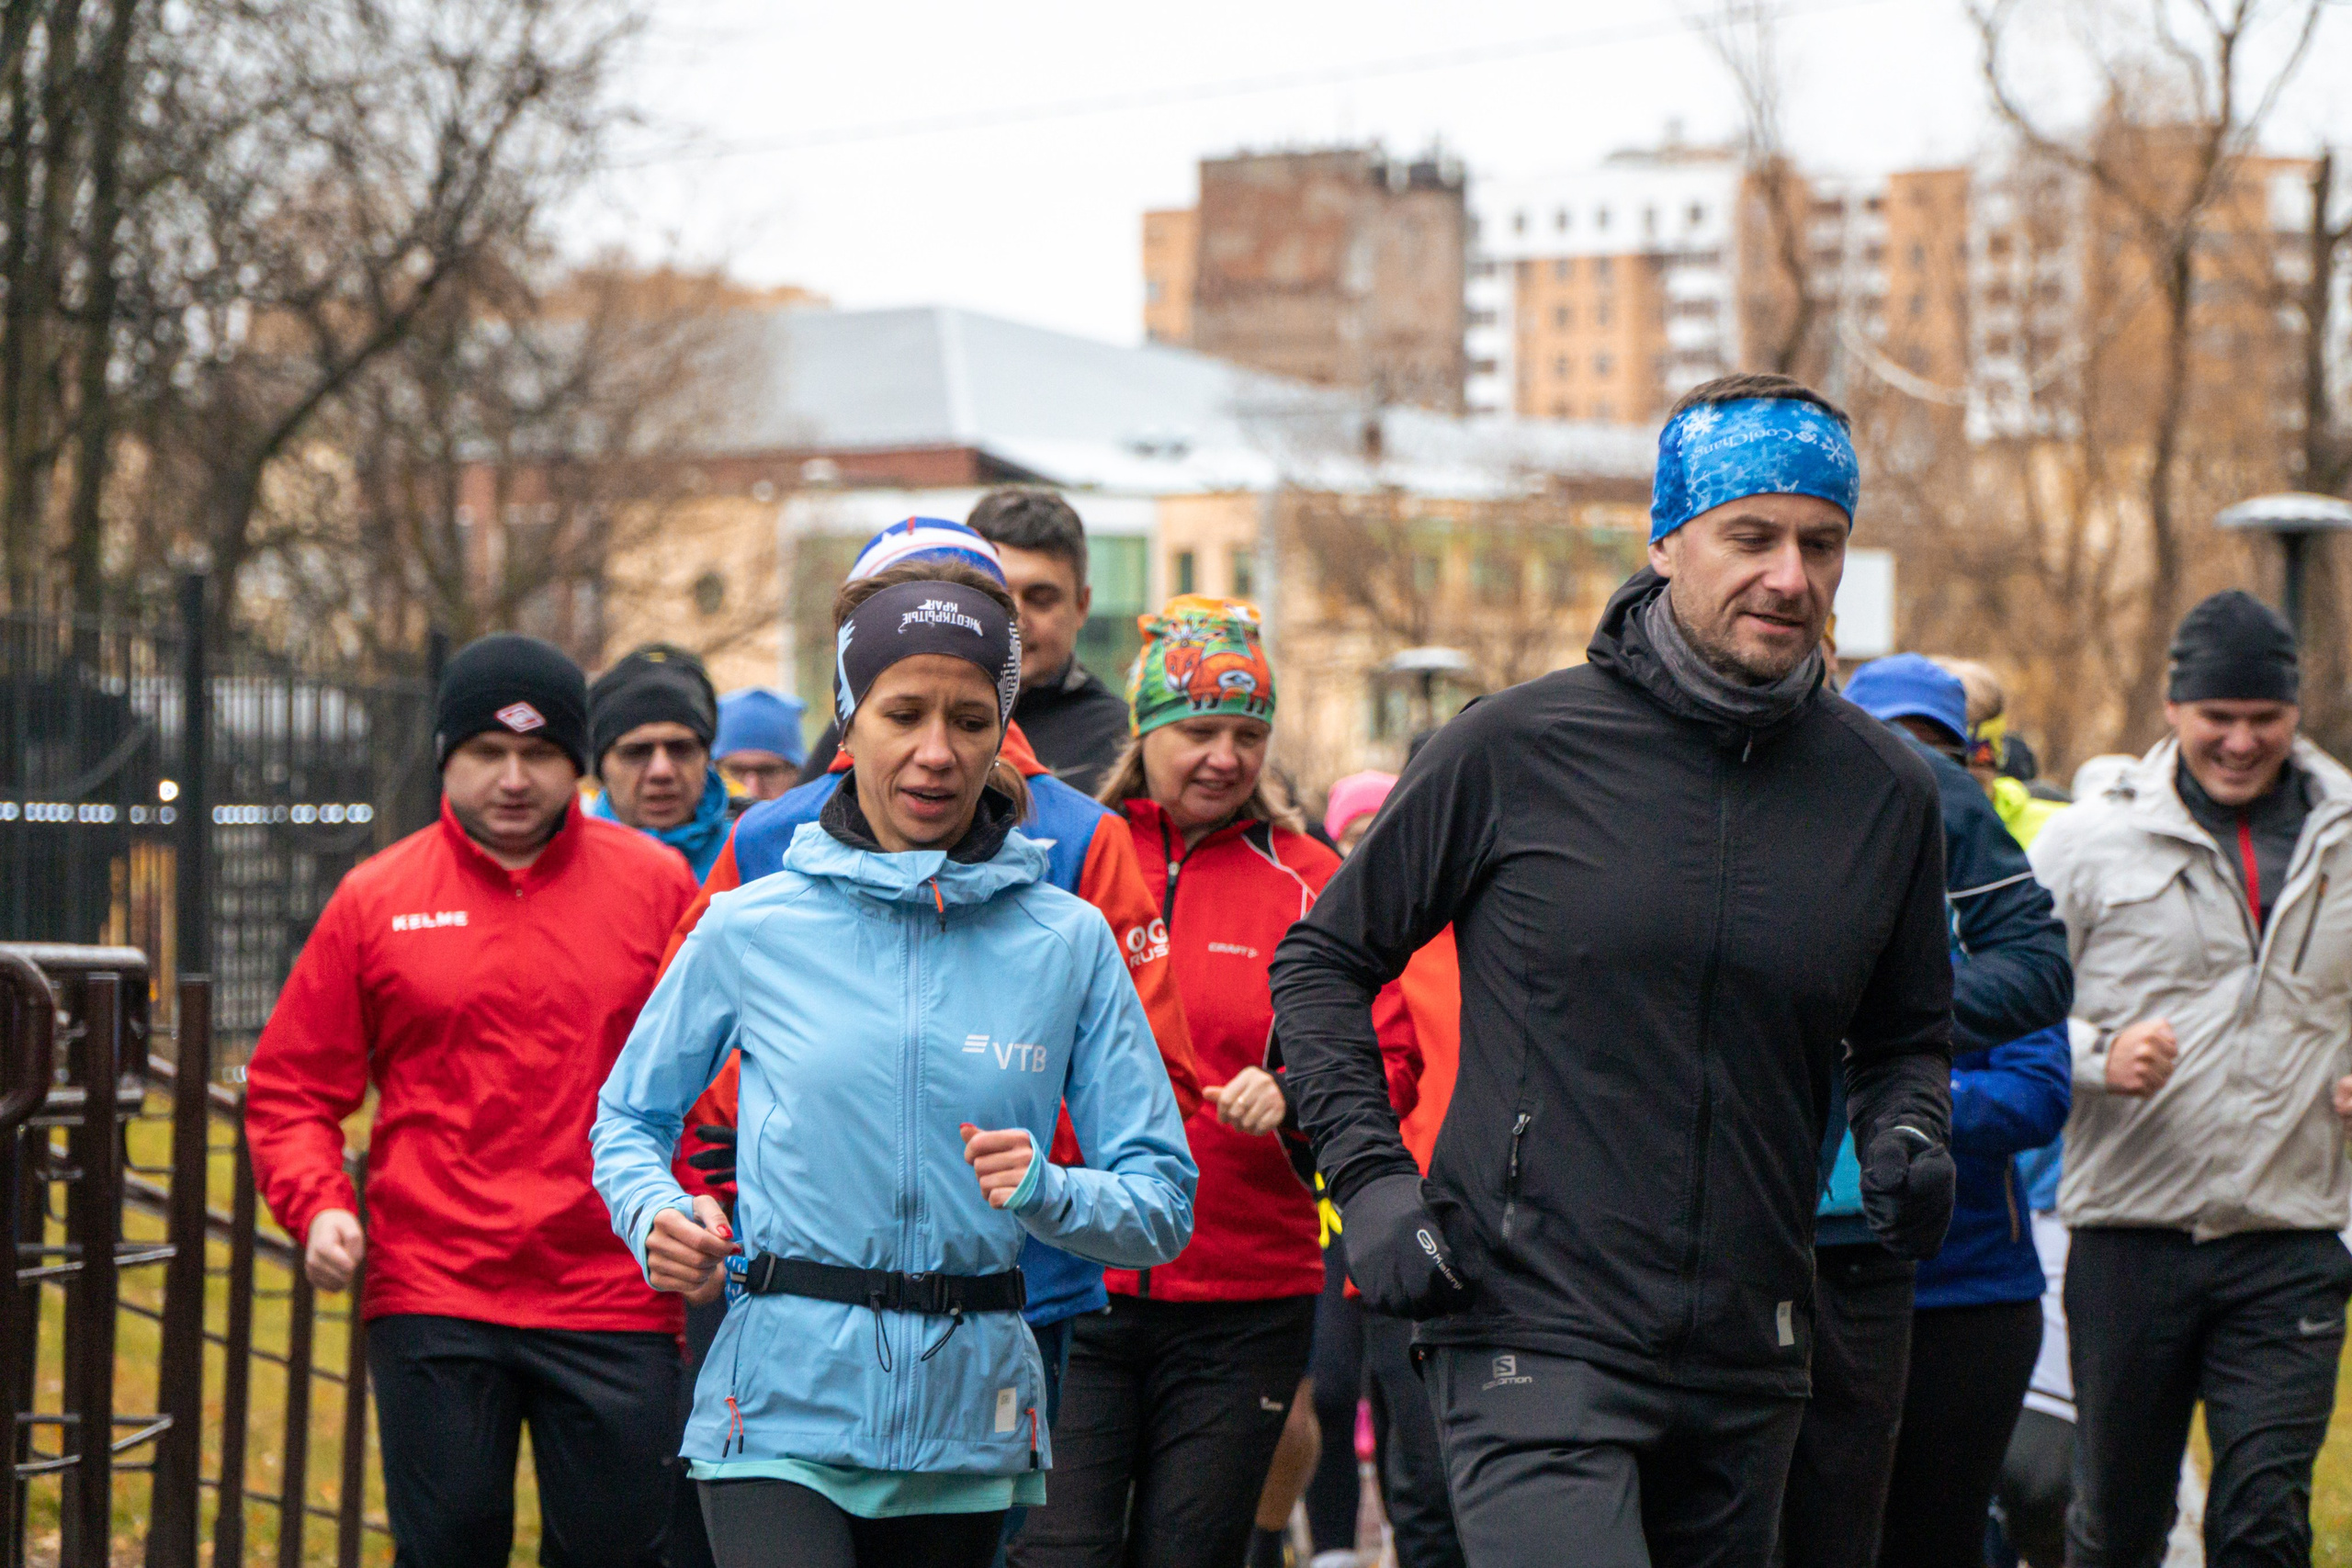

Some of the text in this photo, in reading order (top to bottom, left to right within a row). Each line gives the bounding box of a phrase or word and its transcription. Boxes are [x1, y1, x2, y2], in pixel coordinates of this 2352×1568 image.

[900, 611, 979, 631] НЕОТКРЫТЫЕ
[391, 910, 468, 931] KELME
[1130, 943, 1170, 968] RUS
[992, 1042, 1046, 1073] VTB
